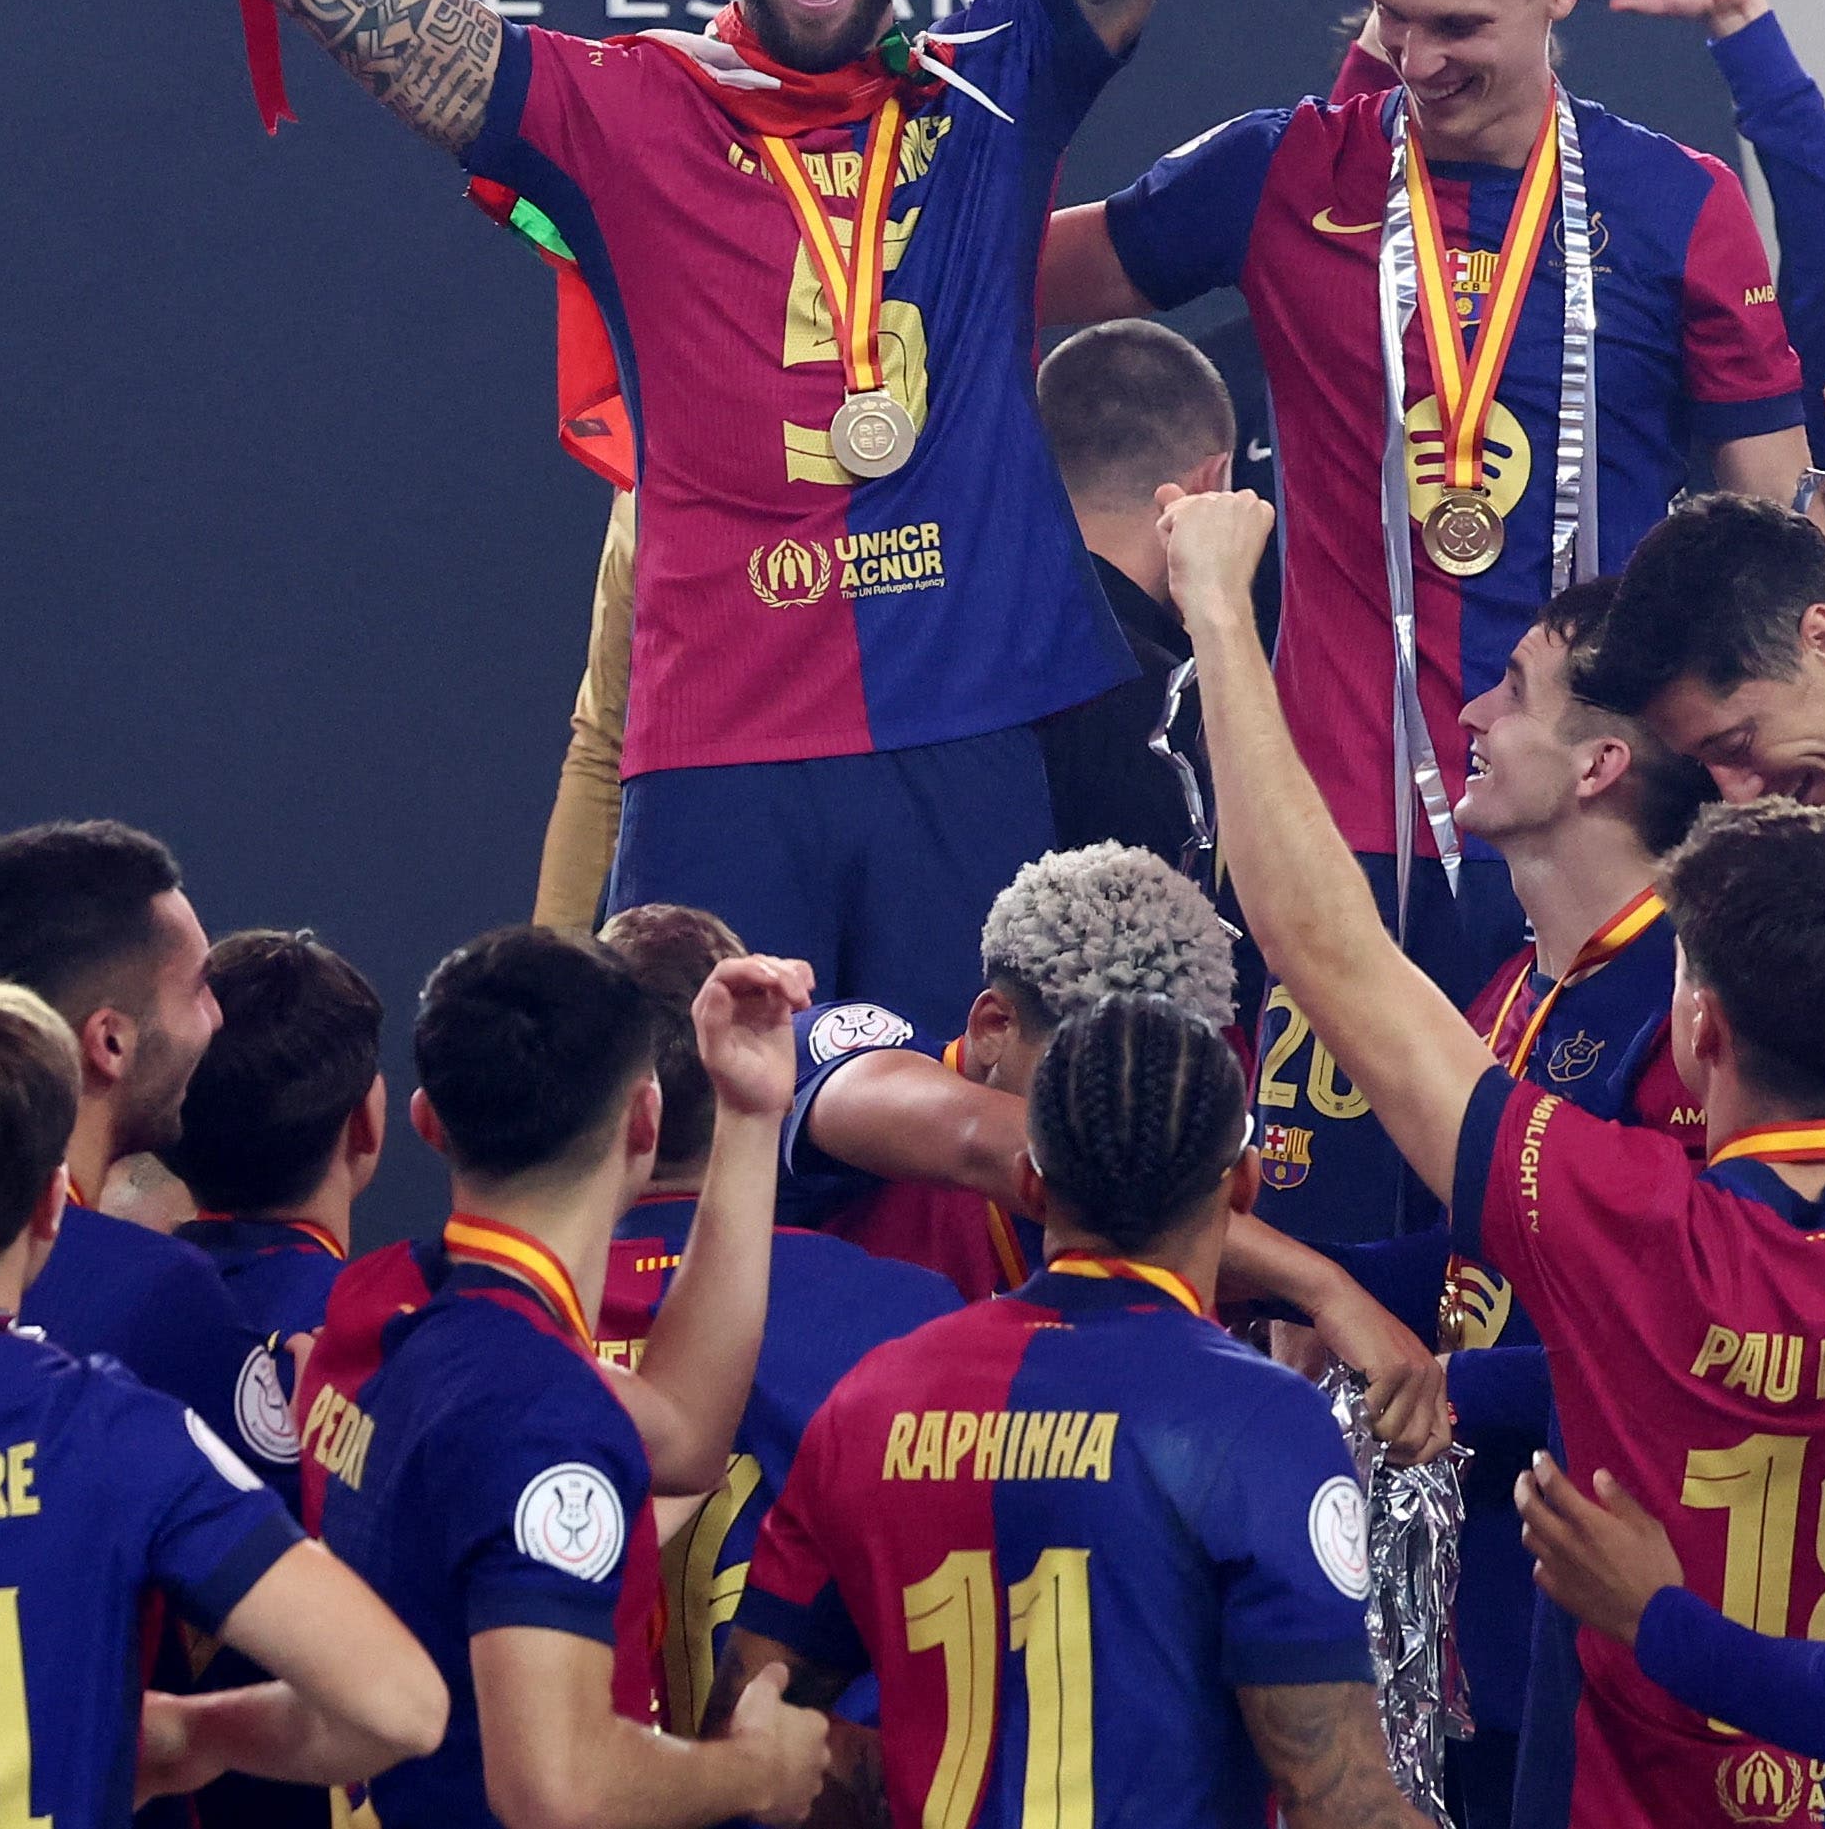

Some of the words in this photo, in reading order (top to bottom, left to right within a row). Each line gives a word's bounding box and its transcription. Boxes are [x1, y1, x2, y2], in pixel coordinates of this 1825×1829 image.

[782, 206, 930, 486] 5
[834, 522, 941, 562] UNHCR
[839, 550, 944, 589] ACNUR
[841, 590, 858, 600] The
[859, 587, 873, 598] UN
[873, 581, 914, 597] Refugee
[915, 577, 946, 591] Agency
[1690, 1323, 1805, 1403] PAU
[301, 1382, 375, 1491] PEDRI
[881, 1409, 1119, 1482] RAPHINHA
[903, 1547, 1093, 1829] 11
